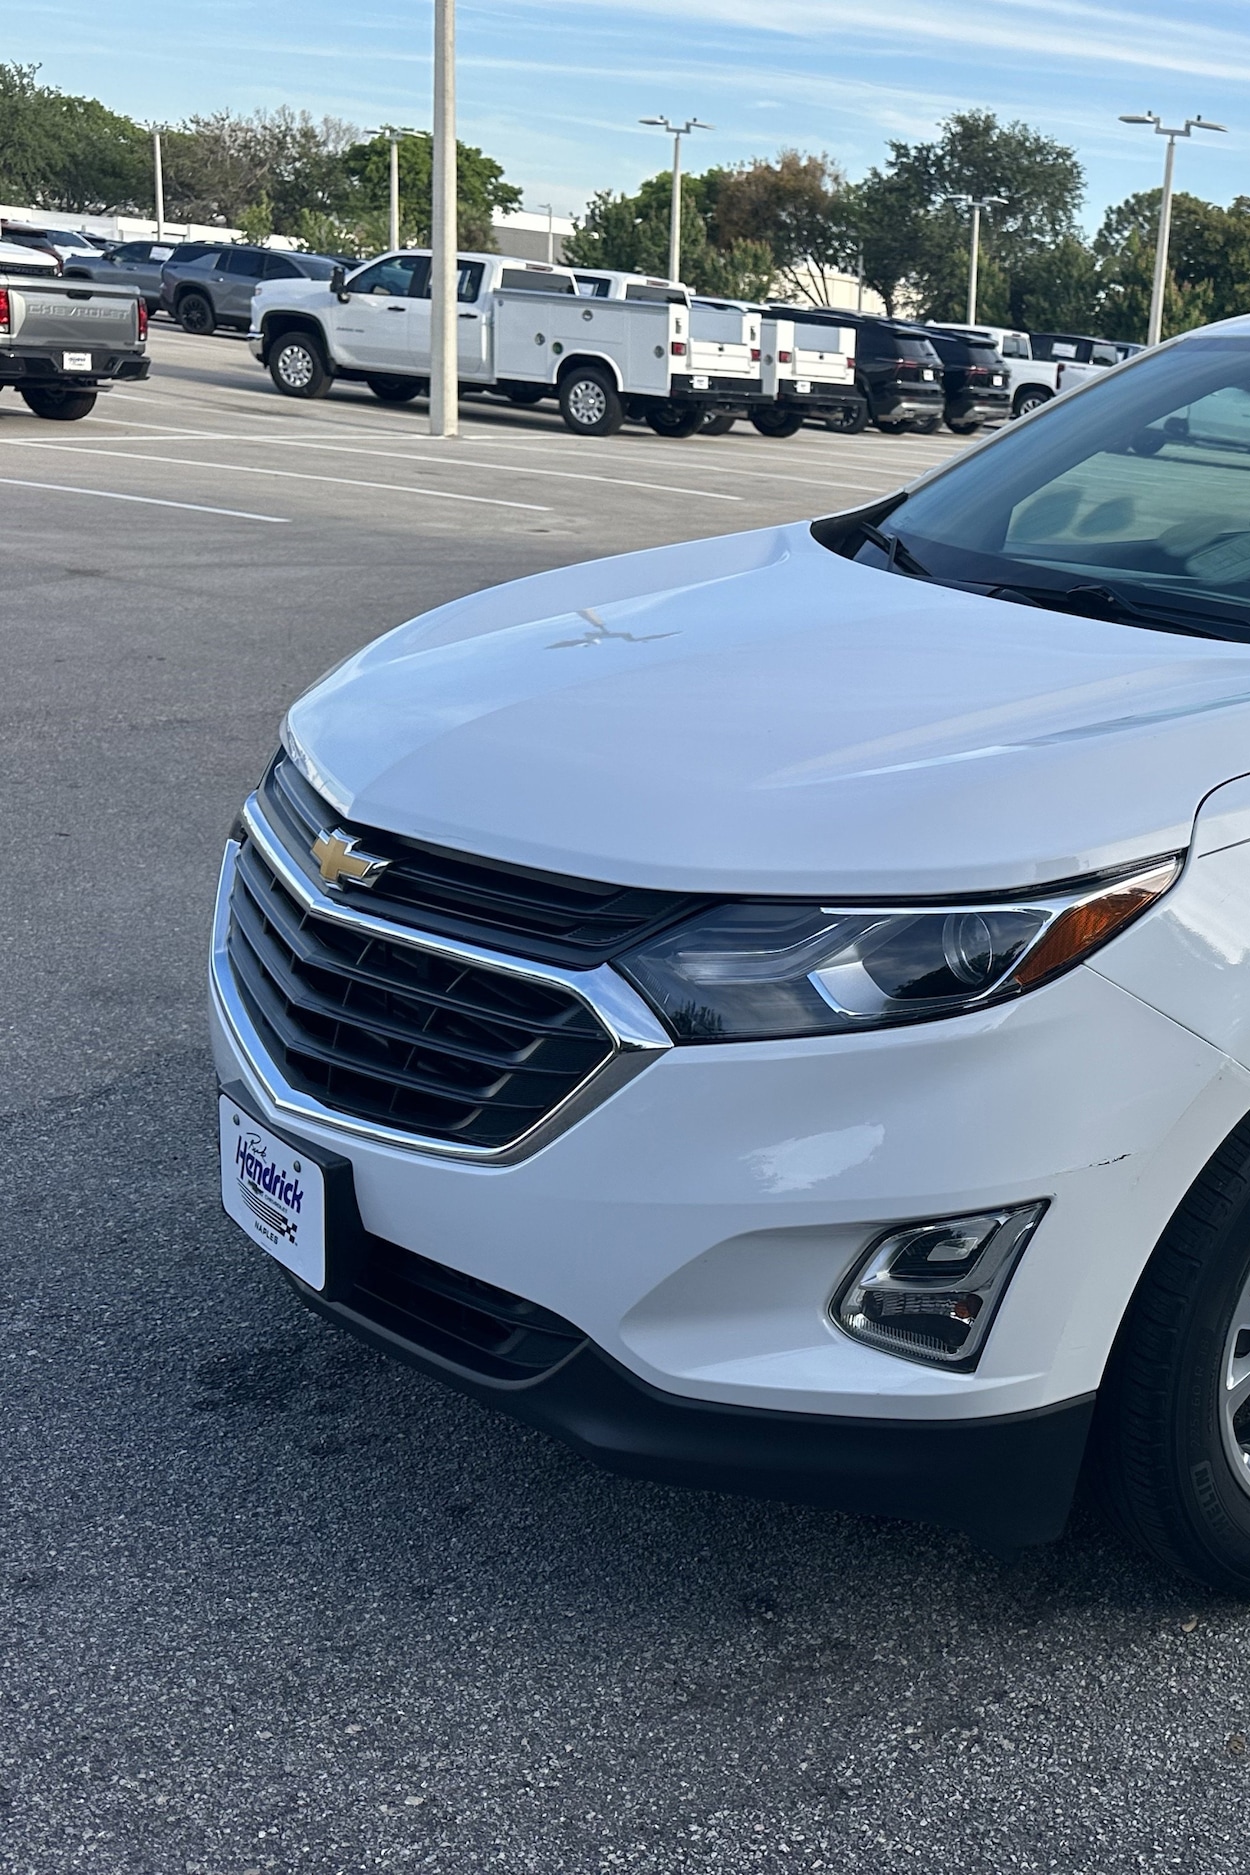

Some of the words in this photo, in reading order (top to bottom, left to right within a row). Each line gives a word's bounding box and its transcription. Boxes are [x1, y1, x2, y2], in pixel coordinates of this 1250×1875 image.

[28, 303, 130, 320] CHEVROLET
[235, 1135, 304, 1214] Hendrick
[254, 1220, 279, 1245] NAPLES
